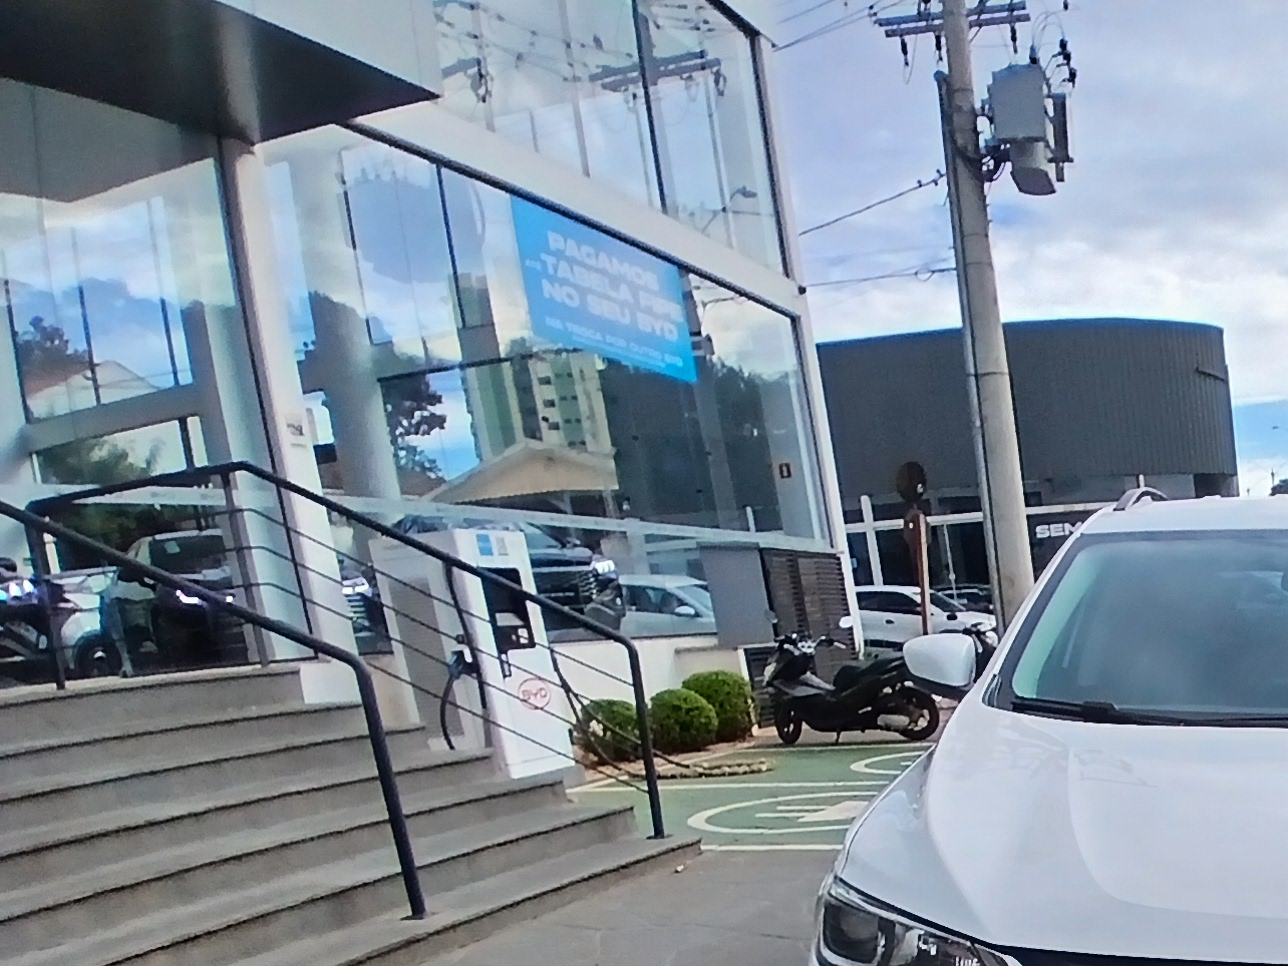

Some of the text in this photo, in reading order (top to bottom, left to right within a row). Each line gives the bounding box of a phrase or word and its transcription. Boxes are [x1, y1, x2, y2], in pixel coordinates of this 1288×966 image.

[540, 252, 634, 304] TABELA
[547, 230, 660, 291] PAGAMOS
[541, 278, 678, 343] NO SEU BYD
[521, 687, 548, 701] BYD
